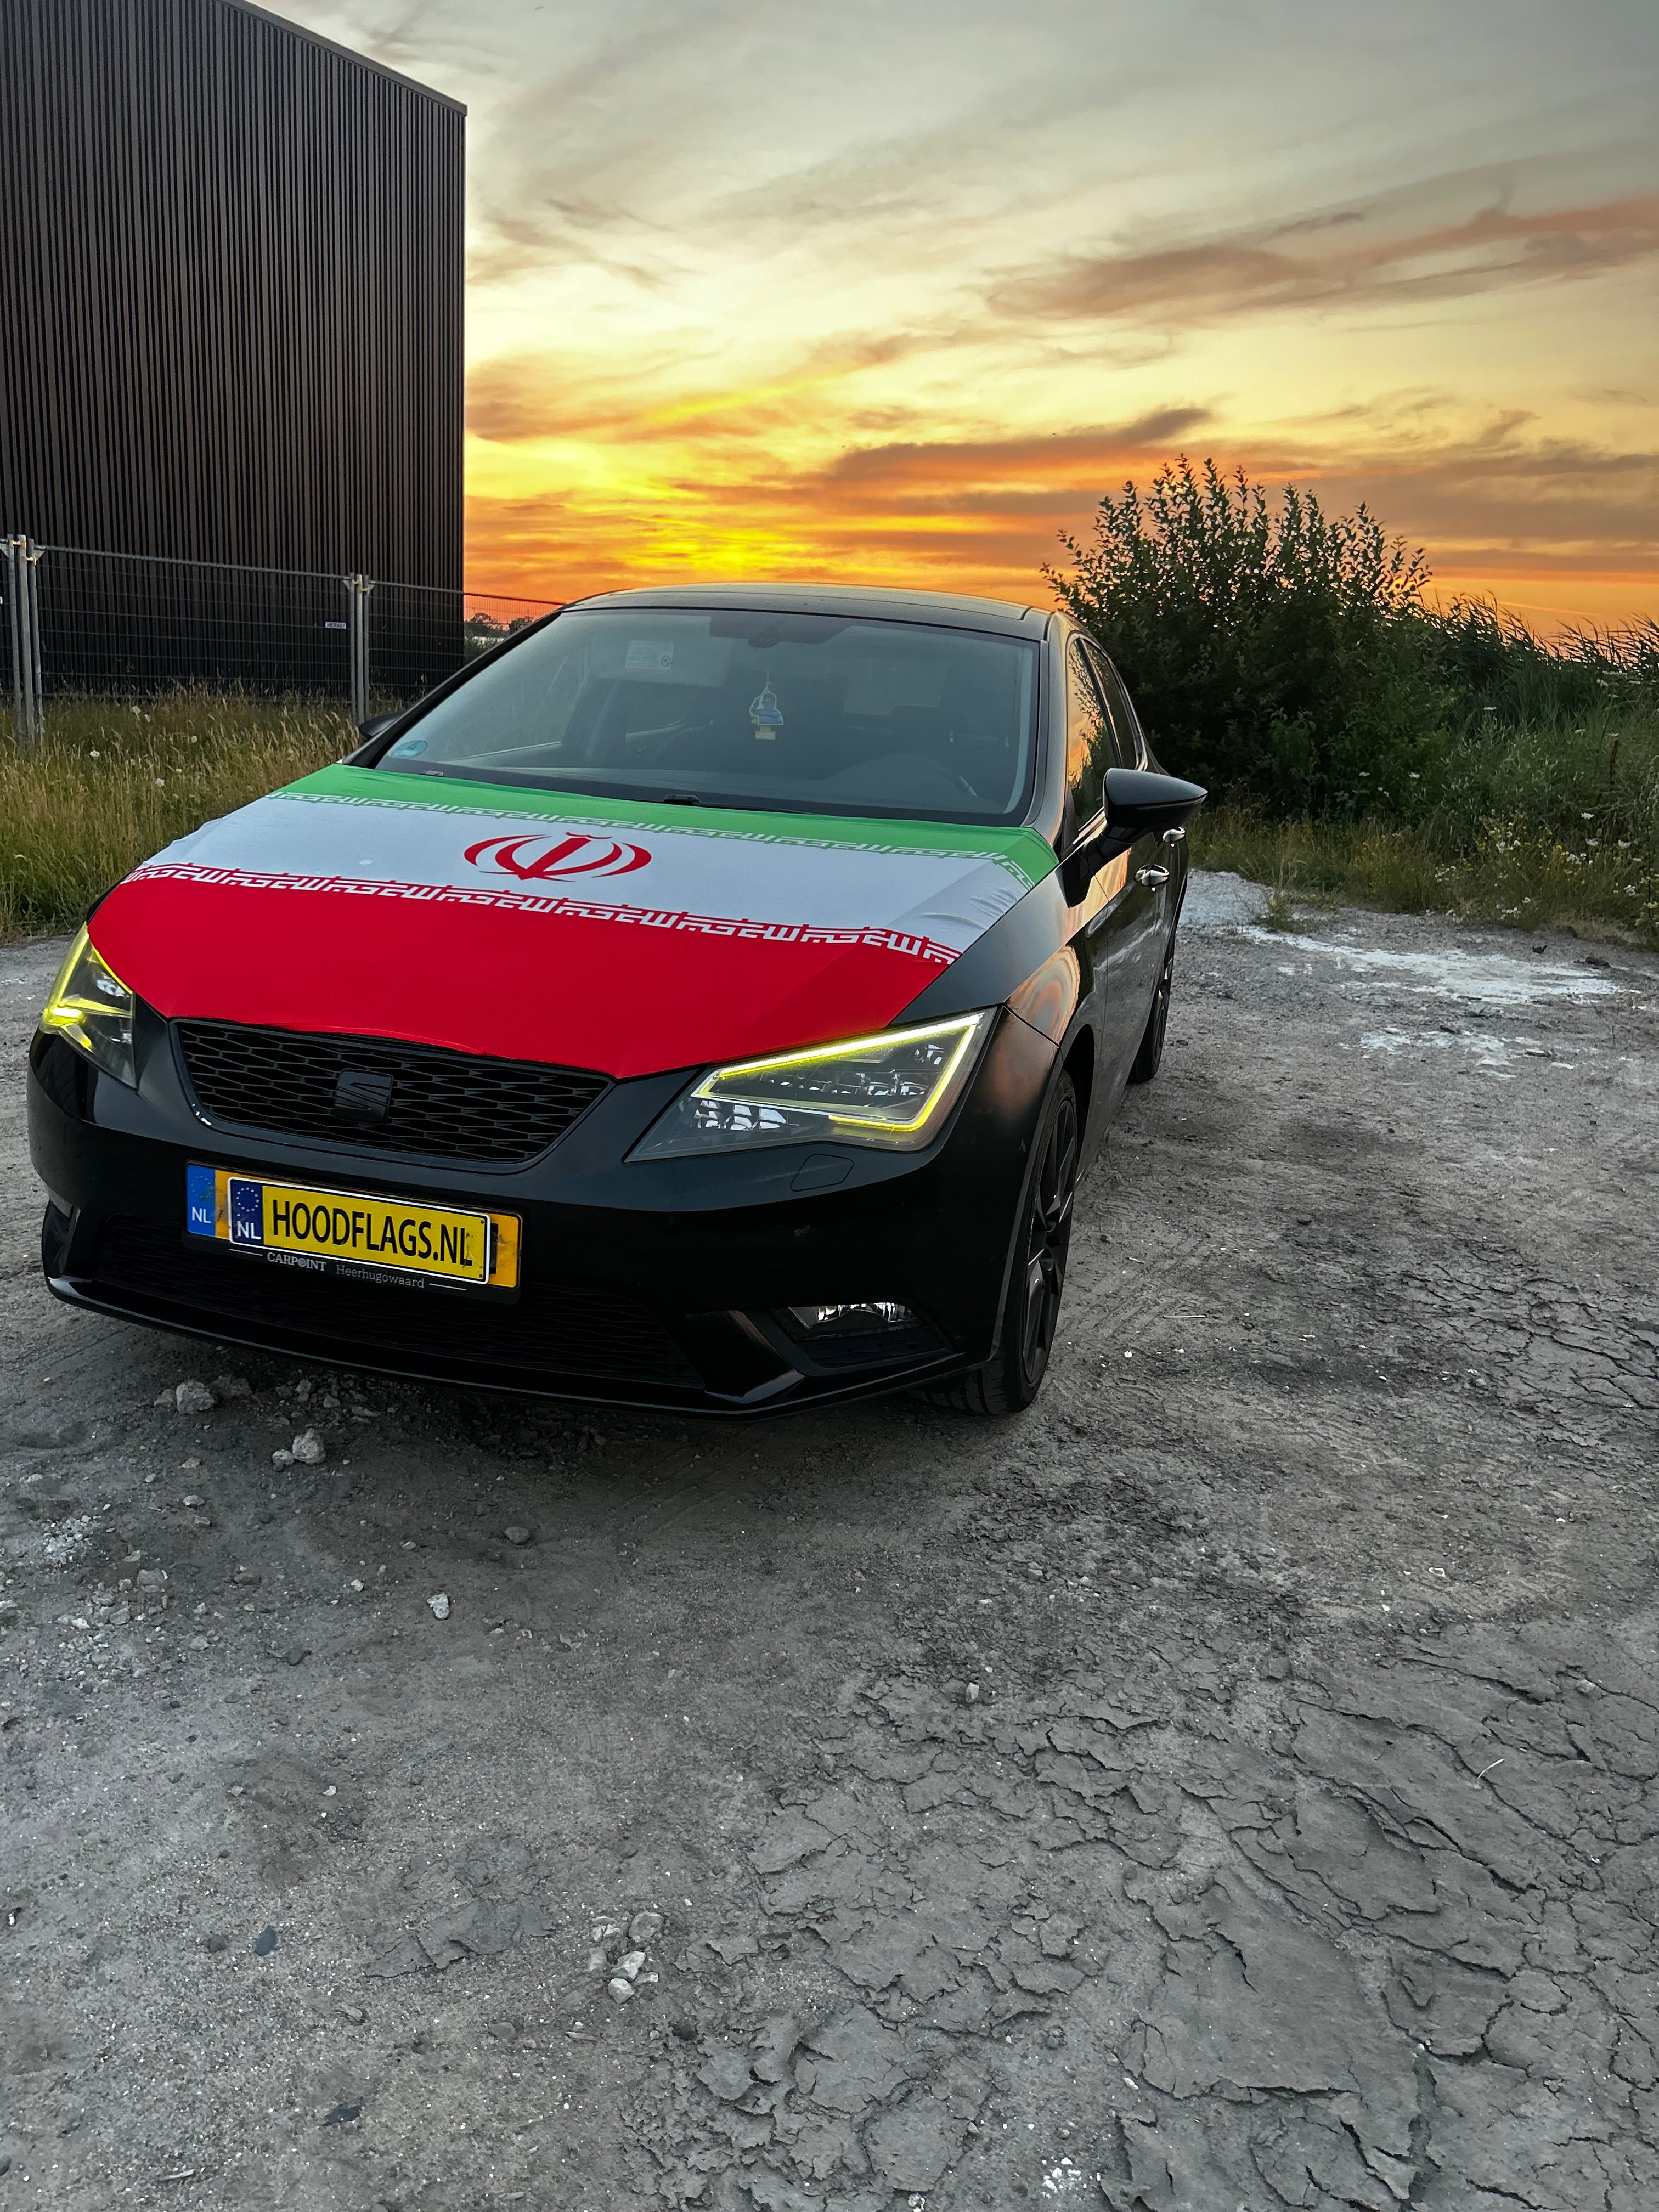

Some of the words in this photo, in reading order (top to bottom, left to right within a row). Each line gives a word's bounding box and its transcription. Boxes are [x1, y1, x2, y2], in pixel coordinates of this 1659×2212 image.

[192, 1206, 211, 1224] NL
[237, 1221, 262, 1240] NL
[273, 1200, 473, 1266] HOODFLAGS.NL
[267, 1251, 327, 1271] CARPOINT
[336, 1264, 425, 1288] Heerhugowaard
